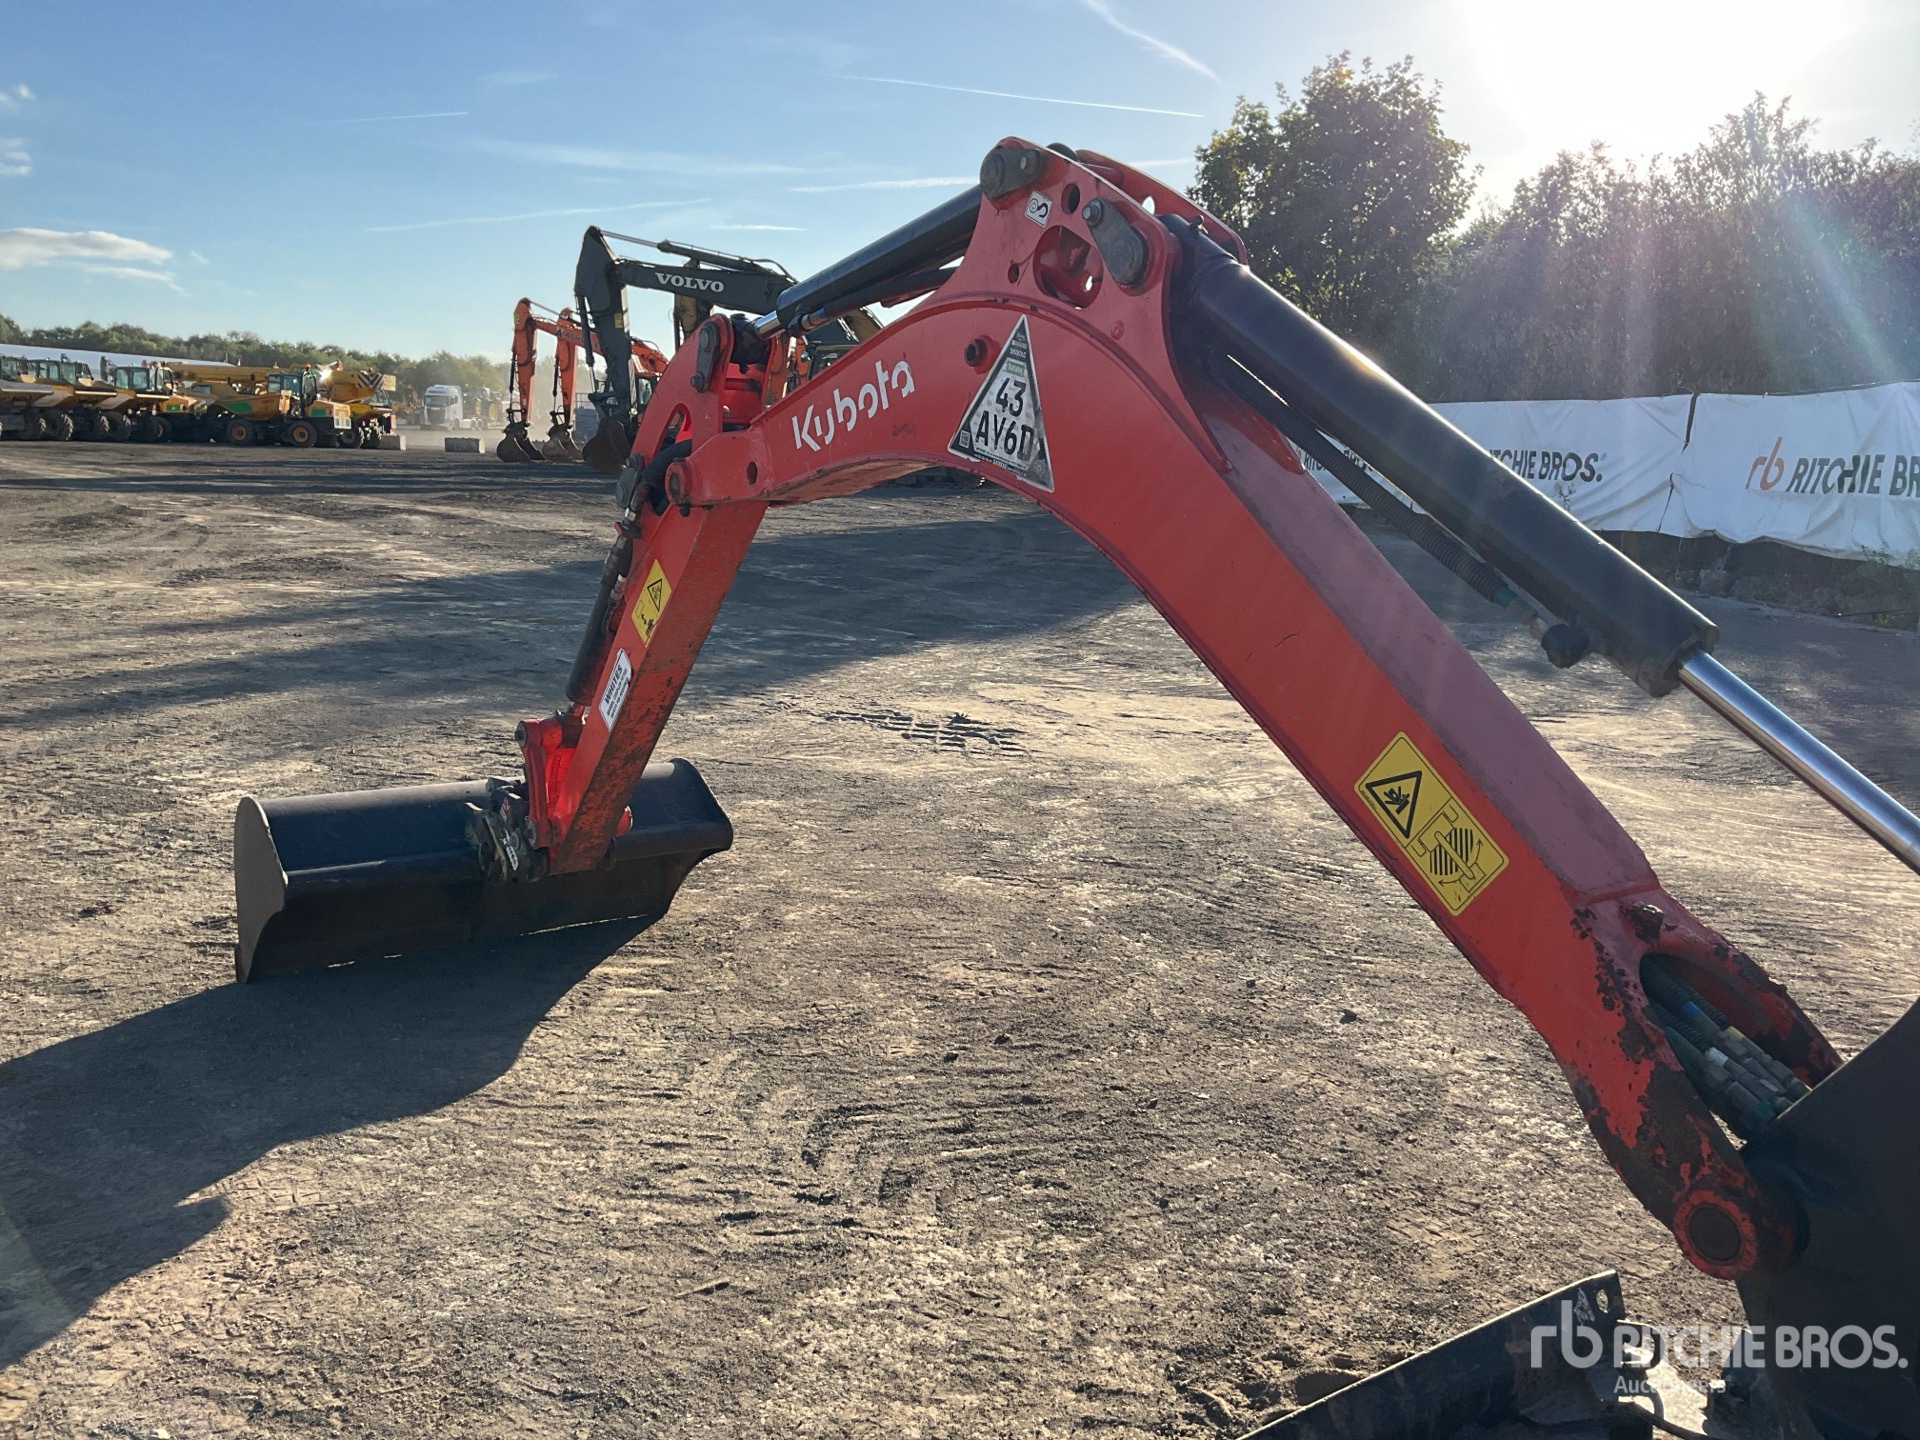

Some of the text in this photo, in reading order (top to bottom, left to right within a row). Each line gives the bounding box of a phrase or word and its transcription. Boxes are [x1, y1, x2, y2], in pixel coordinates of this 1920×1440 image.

[655, 272, 724, 292] VOLVO
[791, 360, 915, 452] Kubota
[995, 377, 1026, 417] 43
[1538, 451, 1603, 482] BROS.
[1785, 454, 1885, 494] RITCHIE
[1889, 454, 1920, 498] BR
[604, 664, 623, 704] WHITES
